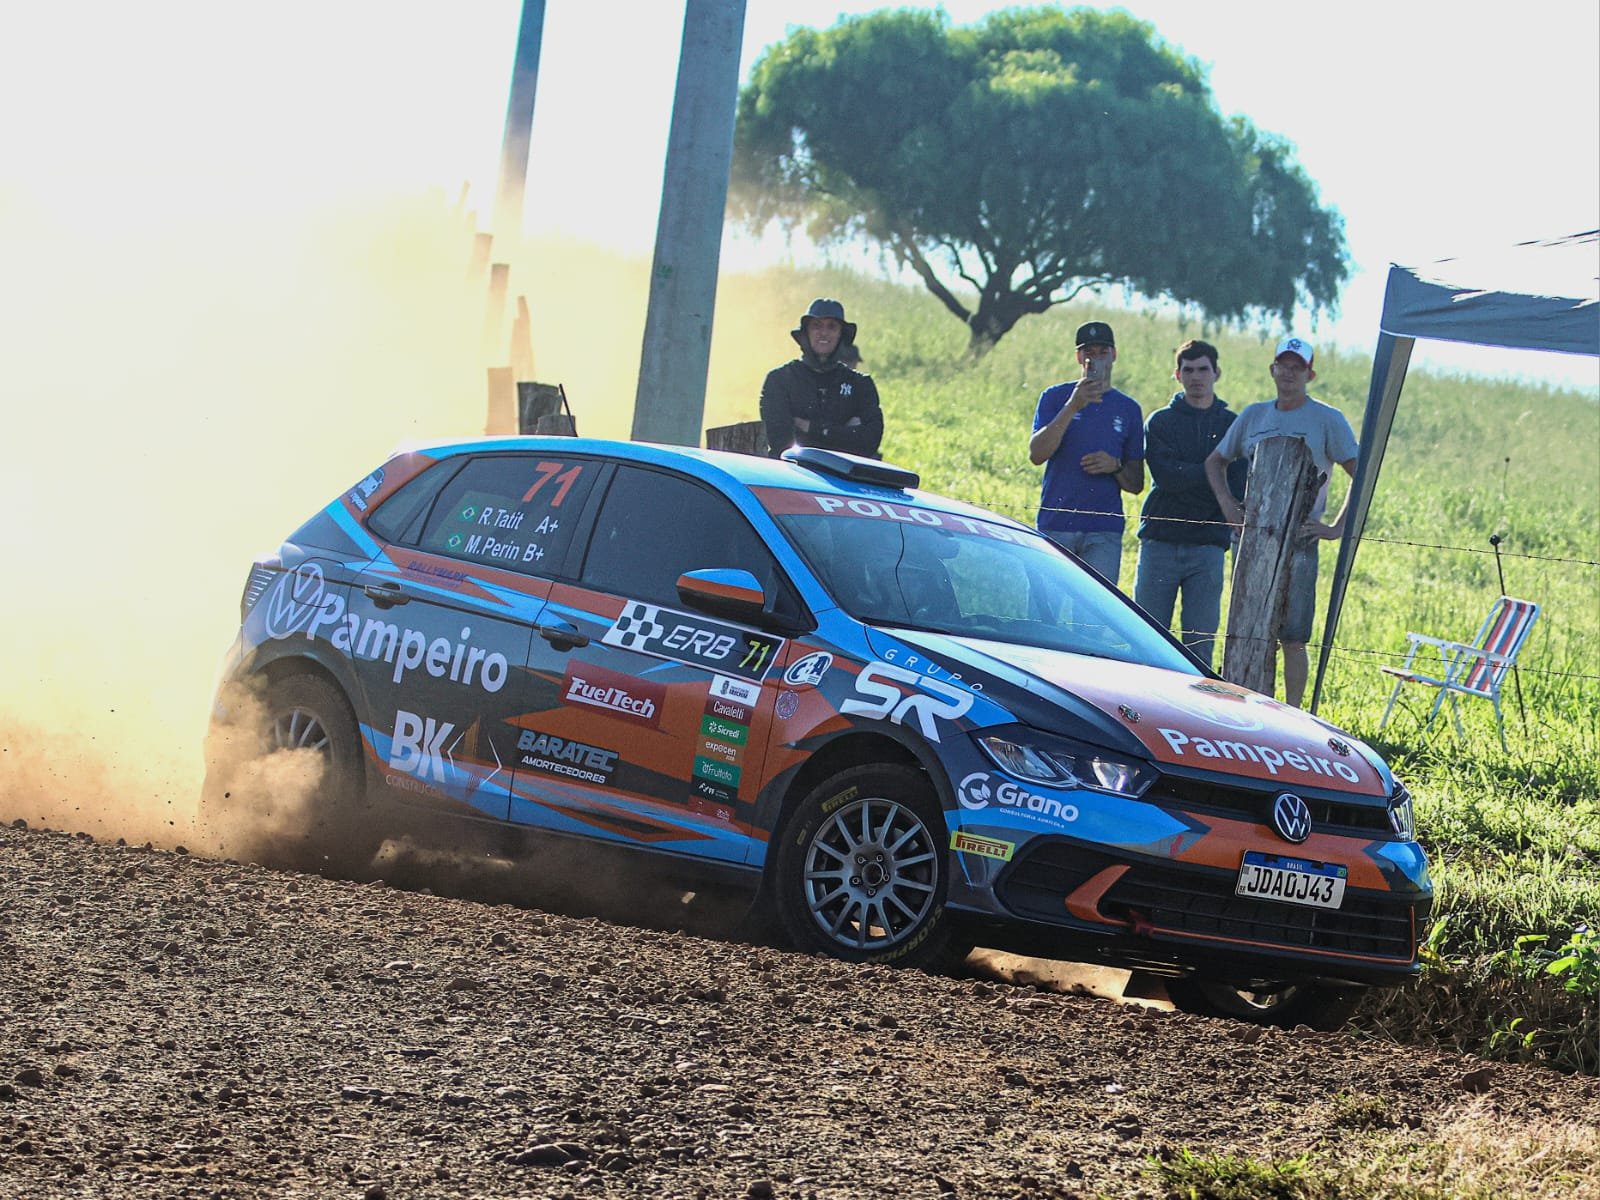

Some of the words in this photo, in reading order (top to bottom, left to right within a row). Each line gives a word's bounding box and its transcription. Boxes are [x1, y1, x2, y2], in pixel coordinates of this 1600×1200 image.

[522, 461, 583, 507] 71
[534, 515, 559, 534] A+
[815, 497, 942, 526] POLO
[523, 543, 544, 562] B+
[306, 593, 508, 693] Pampeiro
[662, 624, 736, 660] ERB
[738, 640, 771, 672] 71
[884, 648, 984, 691] GRUPO
[567, 676, 655, 719] FuelTech
[713, 700, 745, 720] Cavaletti
[839, 661, 975, 744] SR
[389, 709, 456, 783] BK
[517, 729, 619, 773] BARATEC
[717, 725, 741, 739] Sicredi
[521, 755, 606, 784] AMORTECEDORES
[1156, 727, 1360, 783] Pampeiro
[996, 782, 1079, 822] Grano
[955, 833, 1009, 858] PIRELLI
